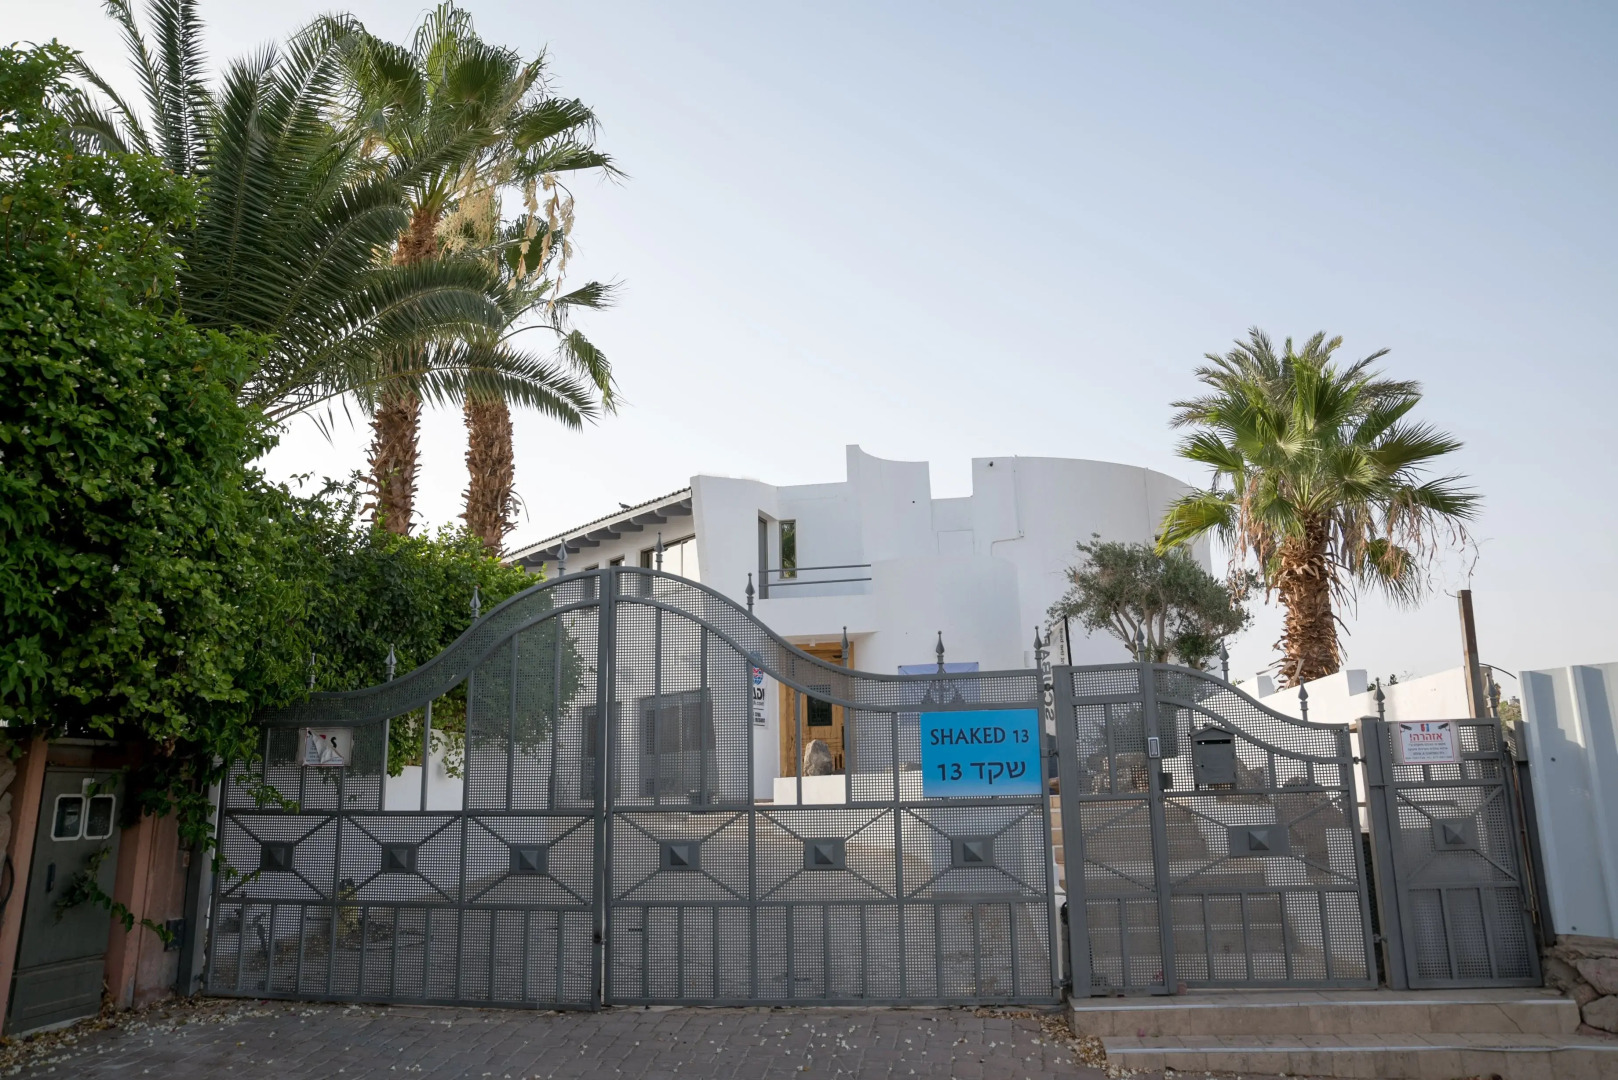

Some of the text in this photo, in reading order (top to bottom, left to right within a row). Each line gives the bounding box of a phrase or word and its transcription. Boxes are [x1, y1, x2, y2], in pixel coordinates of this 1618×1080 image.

[930, 727, 1030, 745] SHAKED 13
[1410, 733, 1443, 741] אזהרה!
[937, 761, 1026, 785] שקד 13
